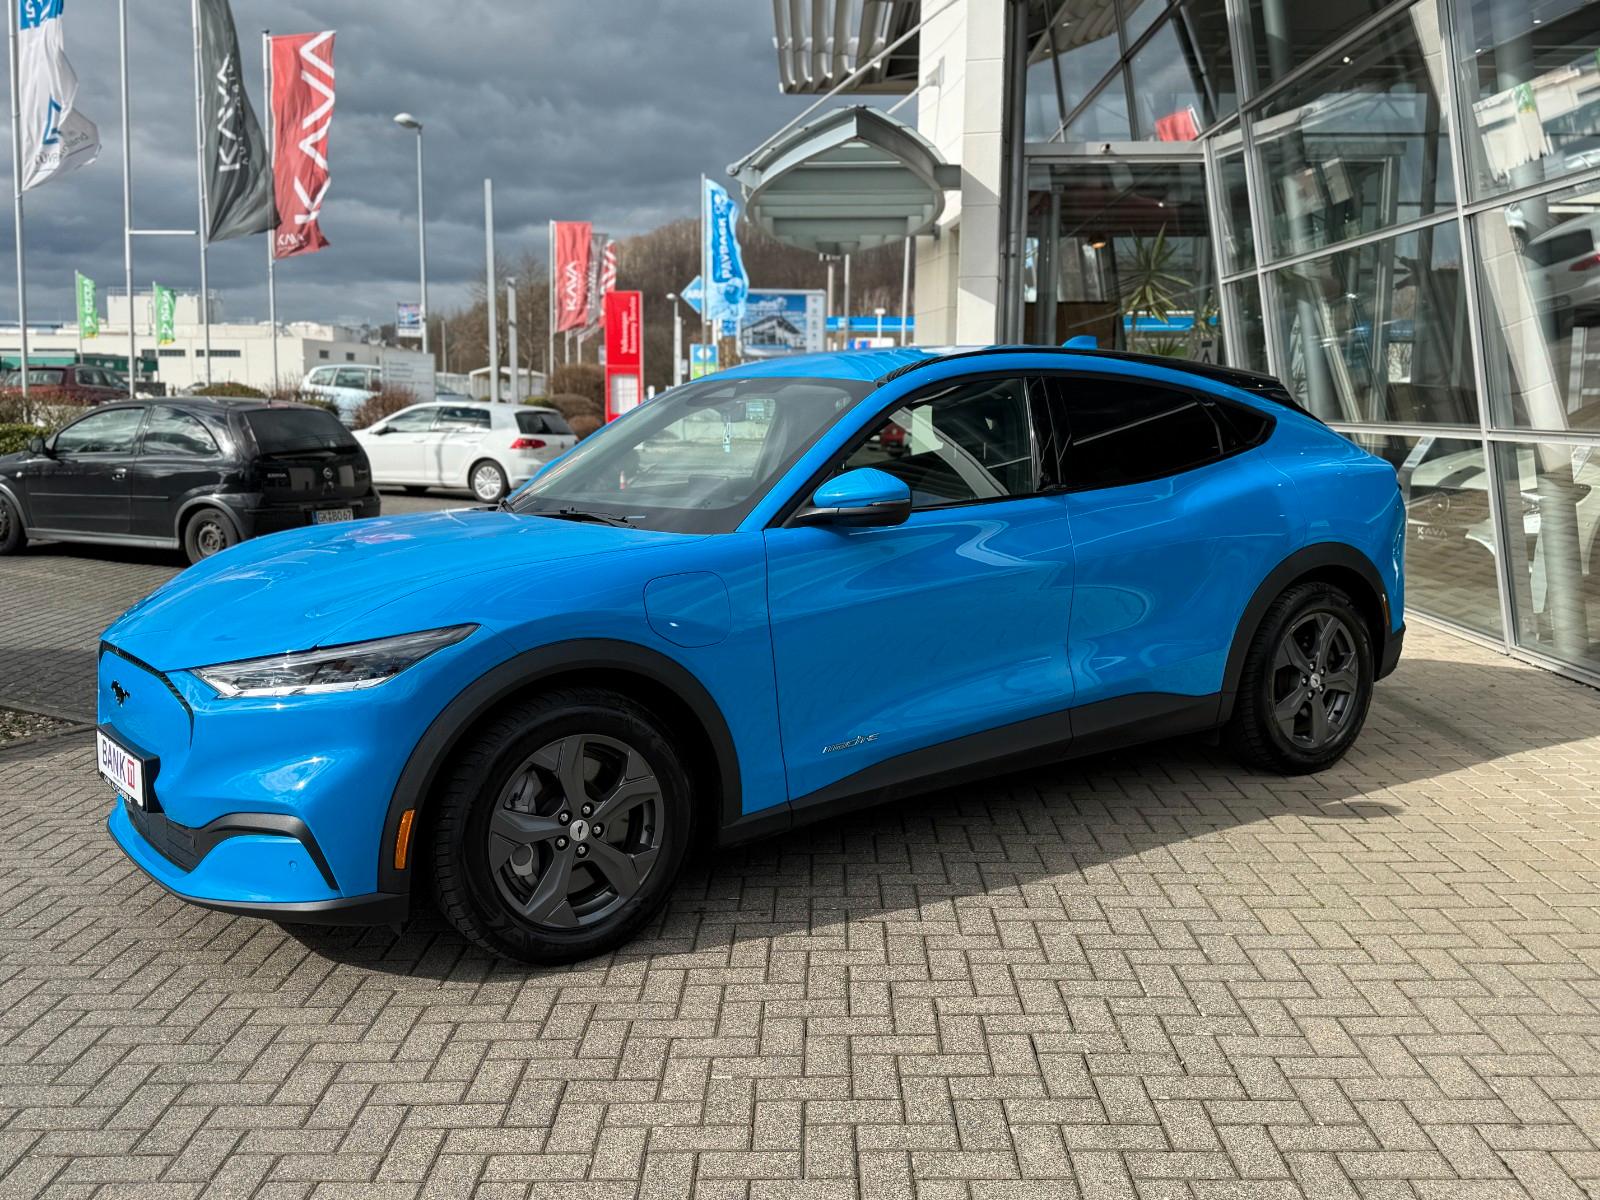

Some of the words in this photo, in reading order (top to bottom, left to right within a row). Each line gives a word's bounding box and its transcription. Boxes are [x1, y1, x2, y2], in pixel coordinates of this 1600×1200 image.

[217, 53, 240, 172] KAVA
[294, 30, 336, 224] KAVA
[566, 261, 577, 311] KAVA
[102, 738, 127, 784] BANK
